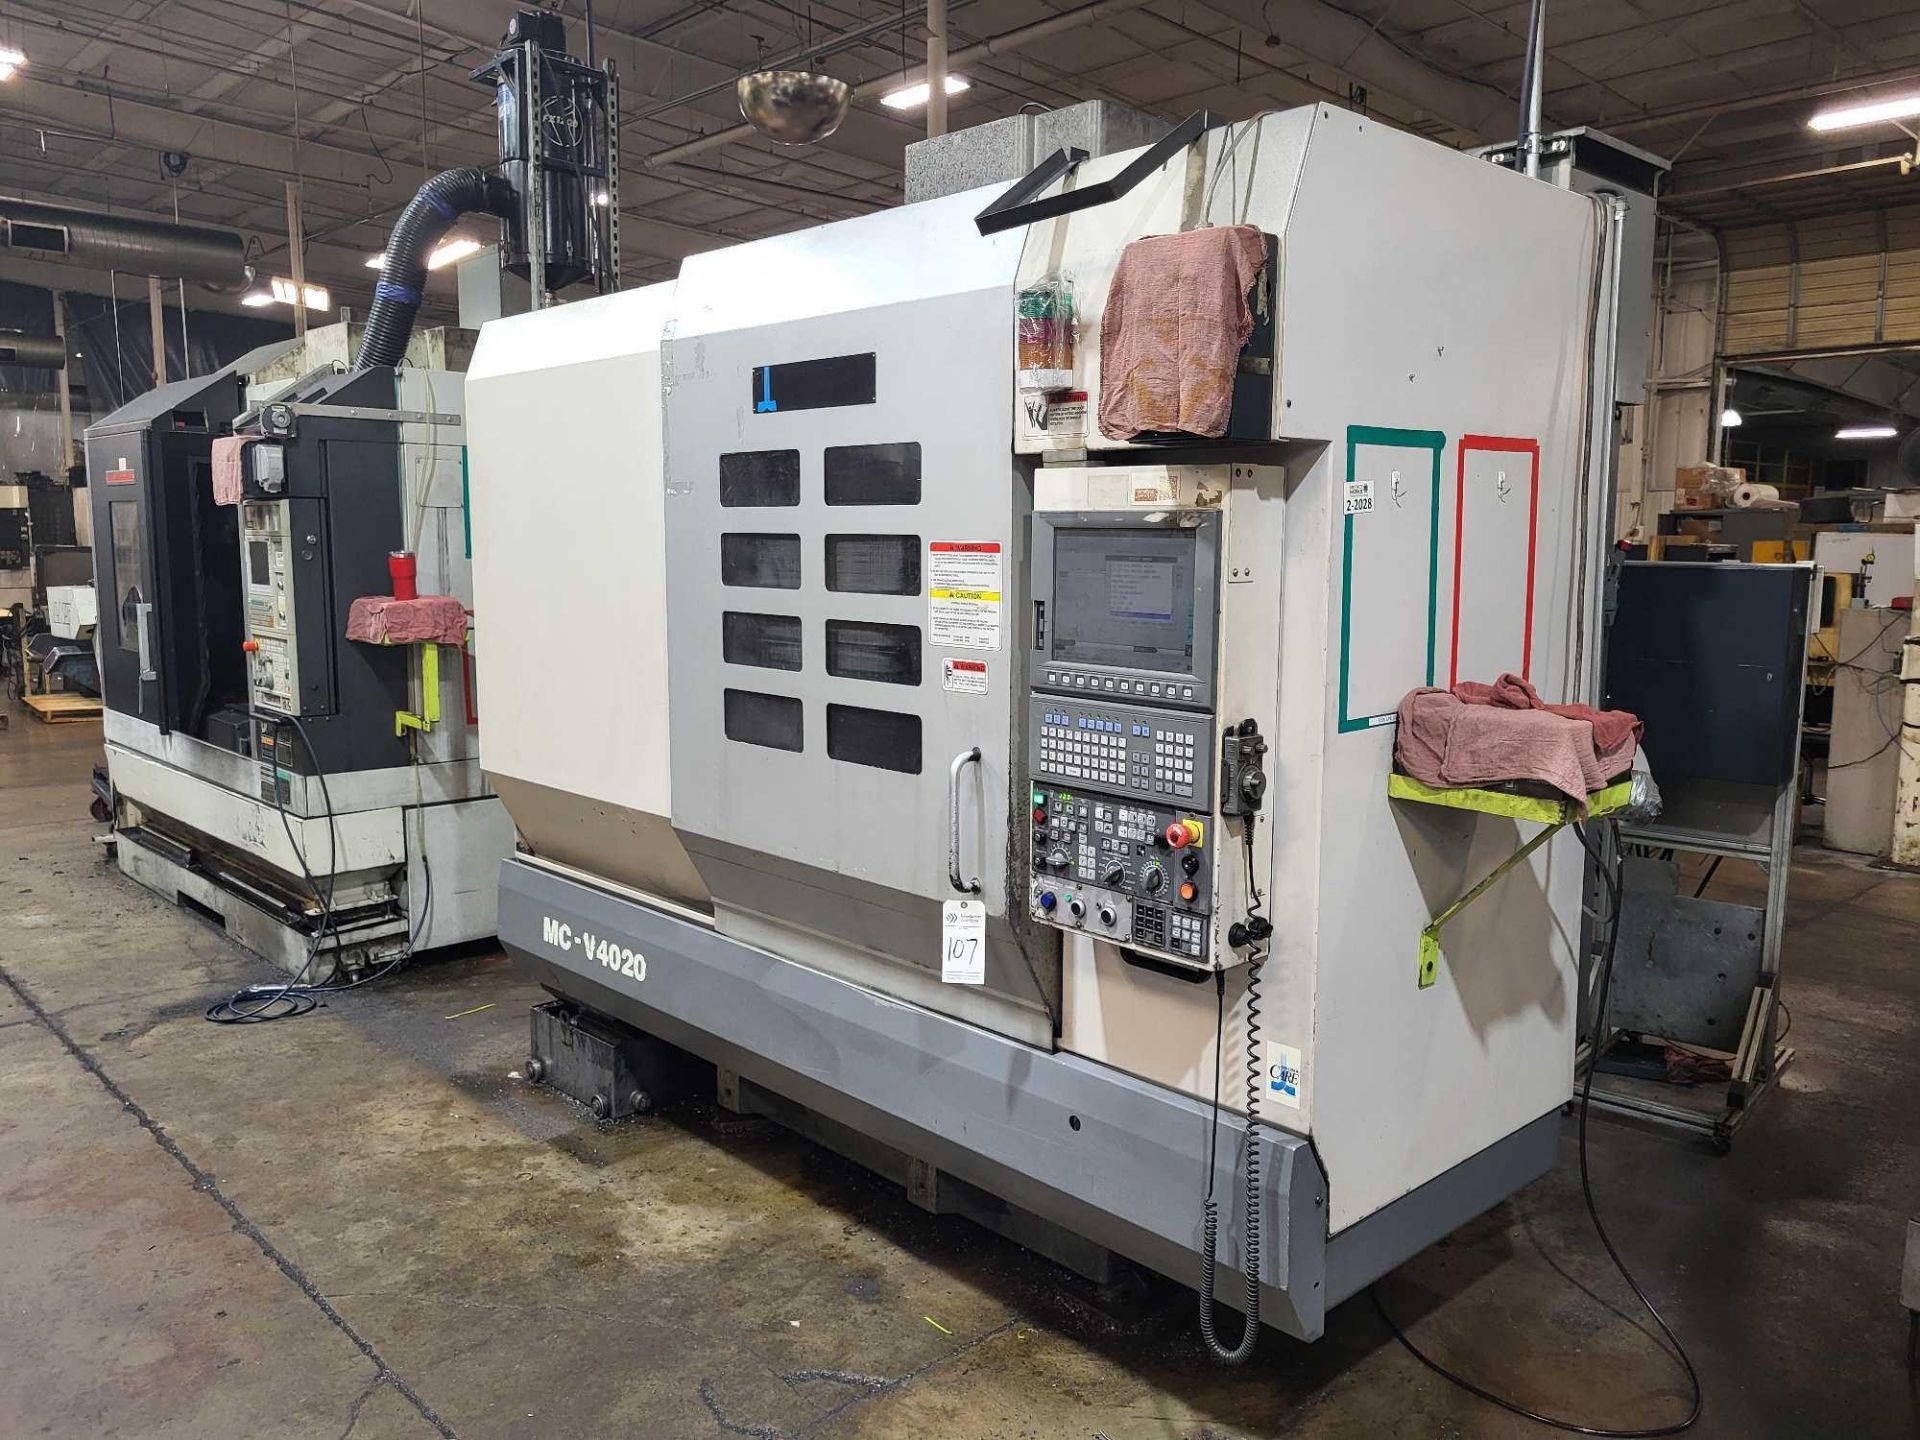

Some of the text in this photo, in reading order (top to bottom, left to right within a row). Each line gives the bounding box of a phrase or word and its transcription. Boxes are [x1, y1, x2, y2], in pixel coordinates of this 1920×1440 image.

[1346, 498, 1372, 512] 2-2028
[955, 592, 982, 600] CAUTION
[543, 916, 647, 982] MC-V4020
[947, 937, 979, 966] 107
